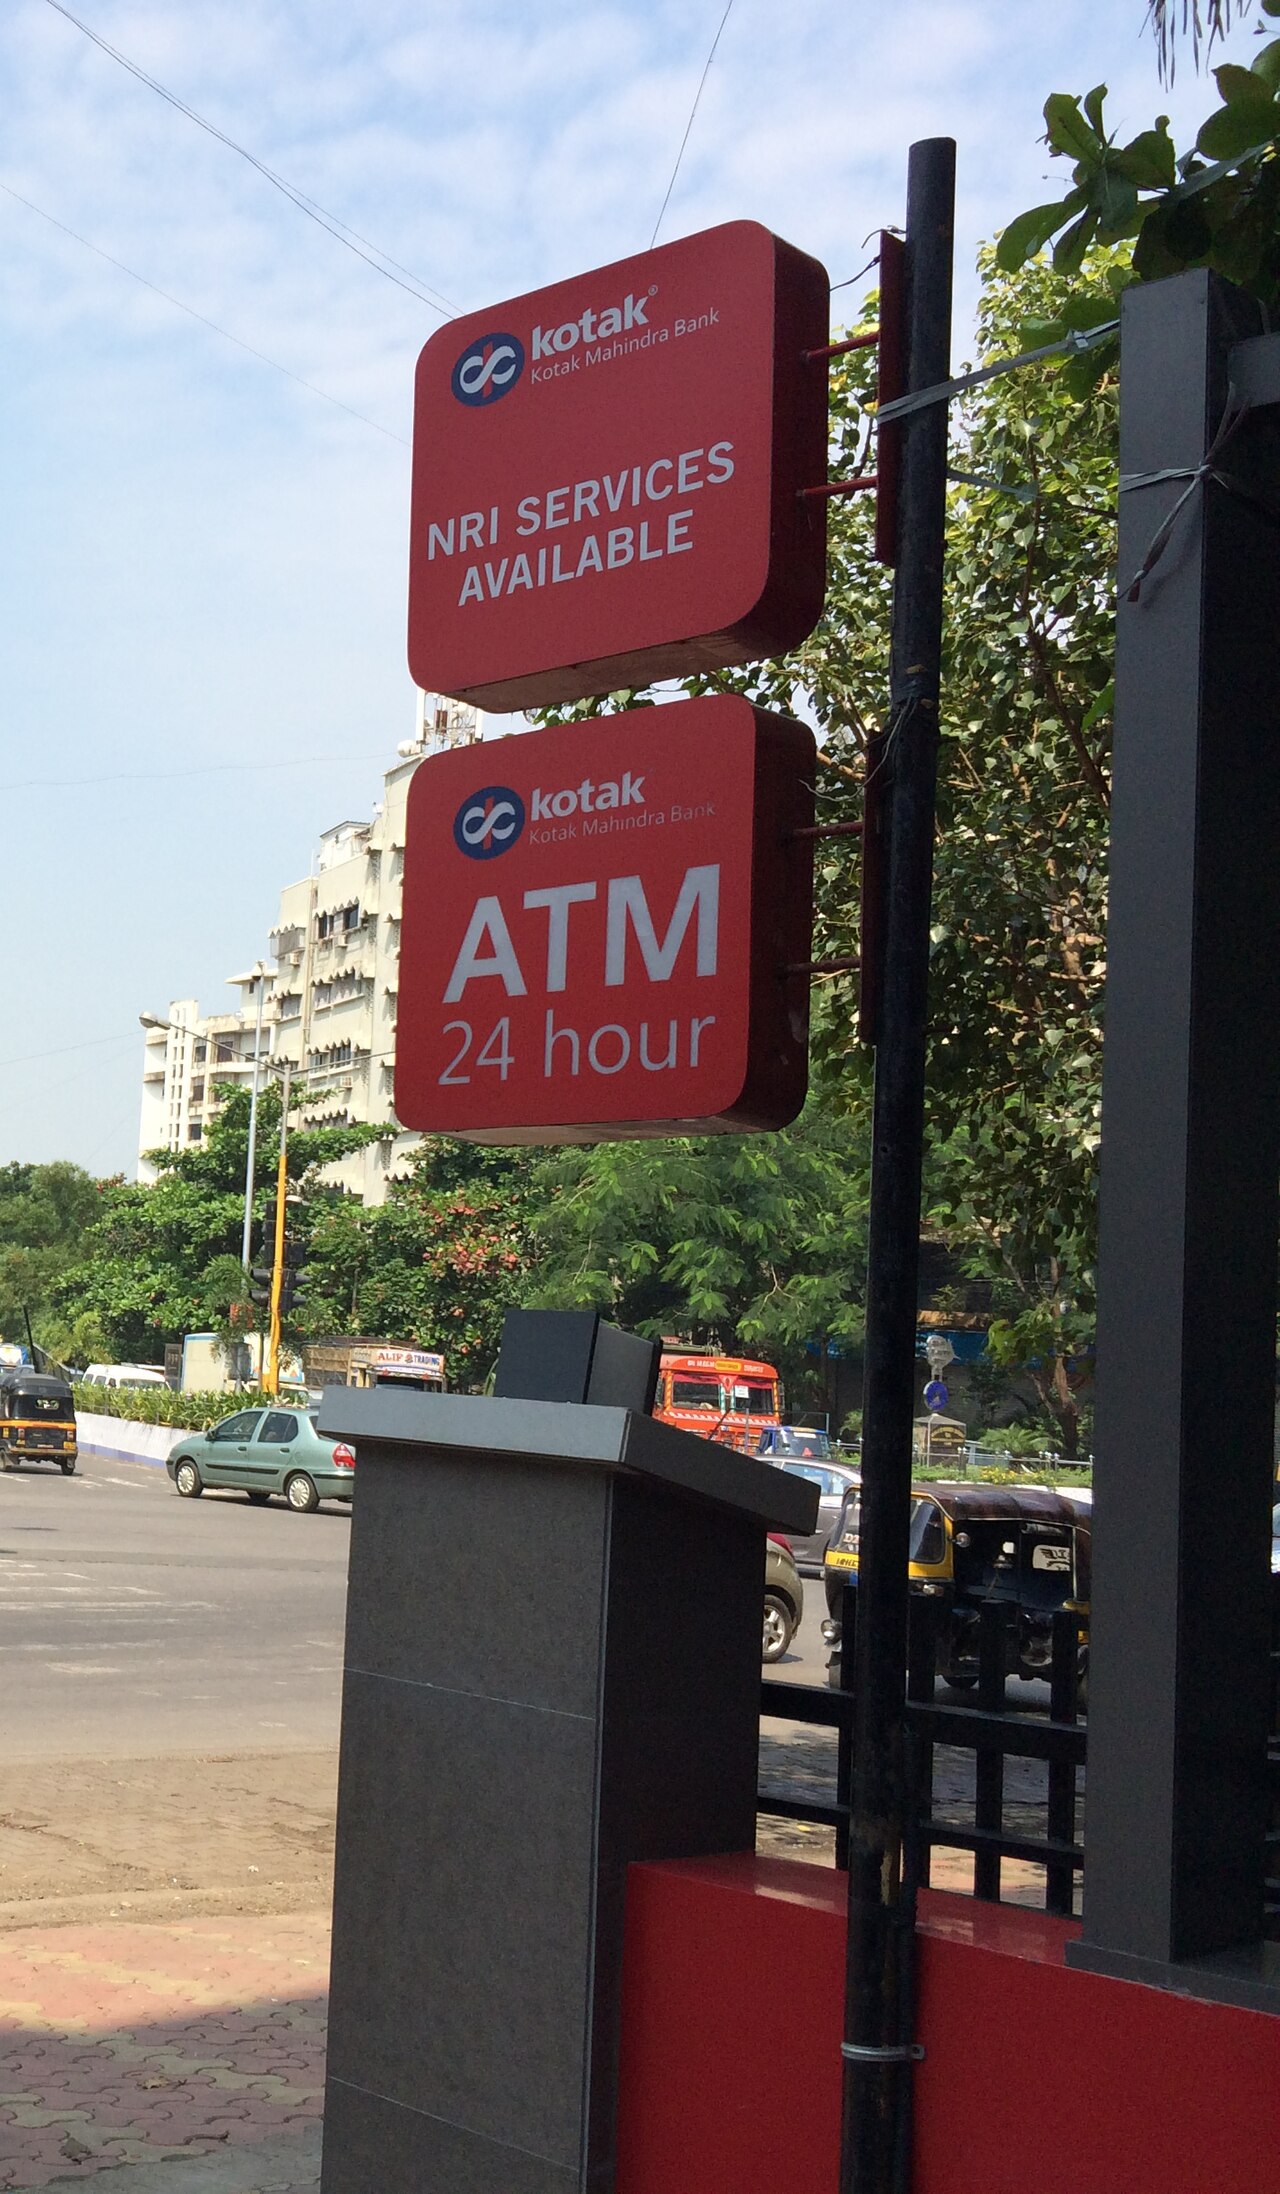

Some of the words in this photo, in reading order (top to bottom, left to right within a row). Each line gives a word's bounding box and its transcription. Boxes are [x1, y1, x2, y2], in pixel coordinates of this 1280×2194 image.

[530, 355, 581, 385] Kotak
[585, 328, 669, 365] Mahindra
[675, 307, 720, 337] Bank
[531, 293, 649, 361] kotak
[427, 506, 498, 561] NRI
[516, 440, 736, 536] SERVICES
[457, 509, 694, 607] AVAILABLE
[529, 824, 578, 846] Kotak
[582, 810, 666, 836] Mahindra
[671, 801, 717, 823] Bank
[530, 770, 646, 822] kotak
[442, 863, 721, 1004] ATM
[438, 1016, 515, 1086] 24
[543, 1008, 717, 1078] hour
